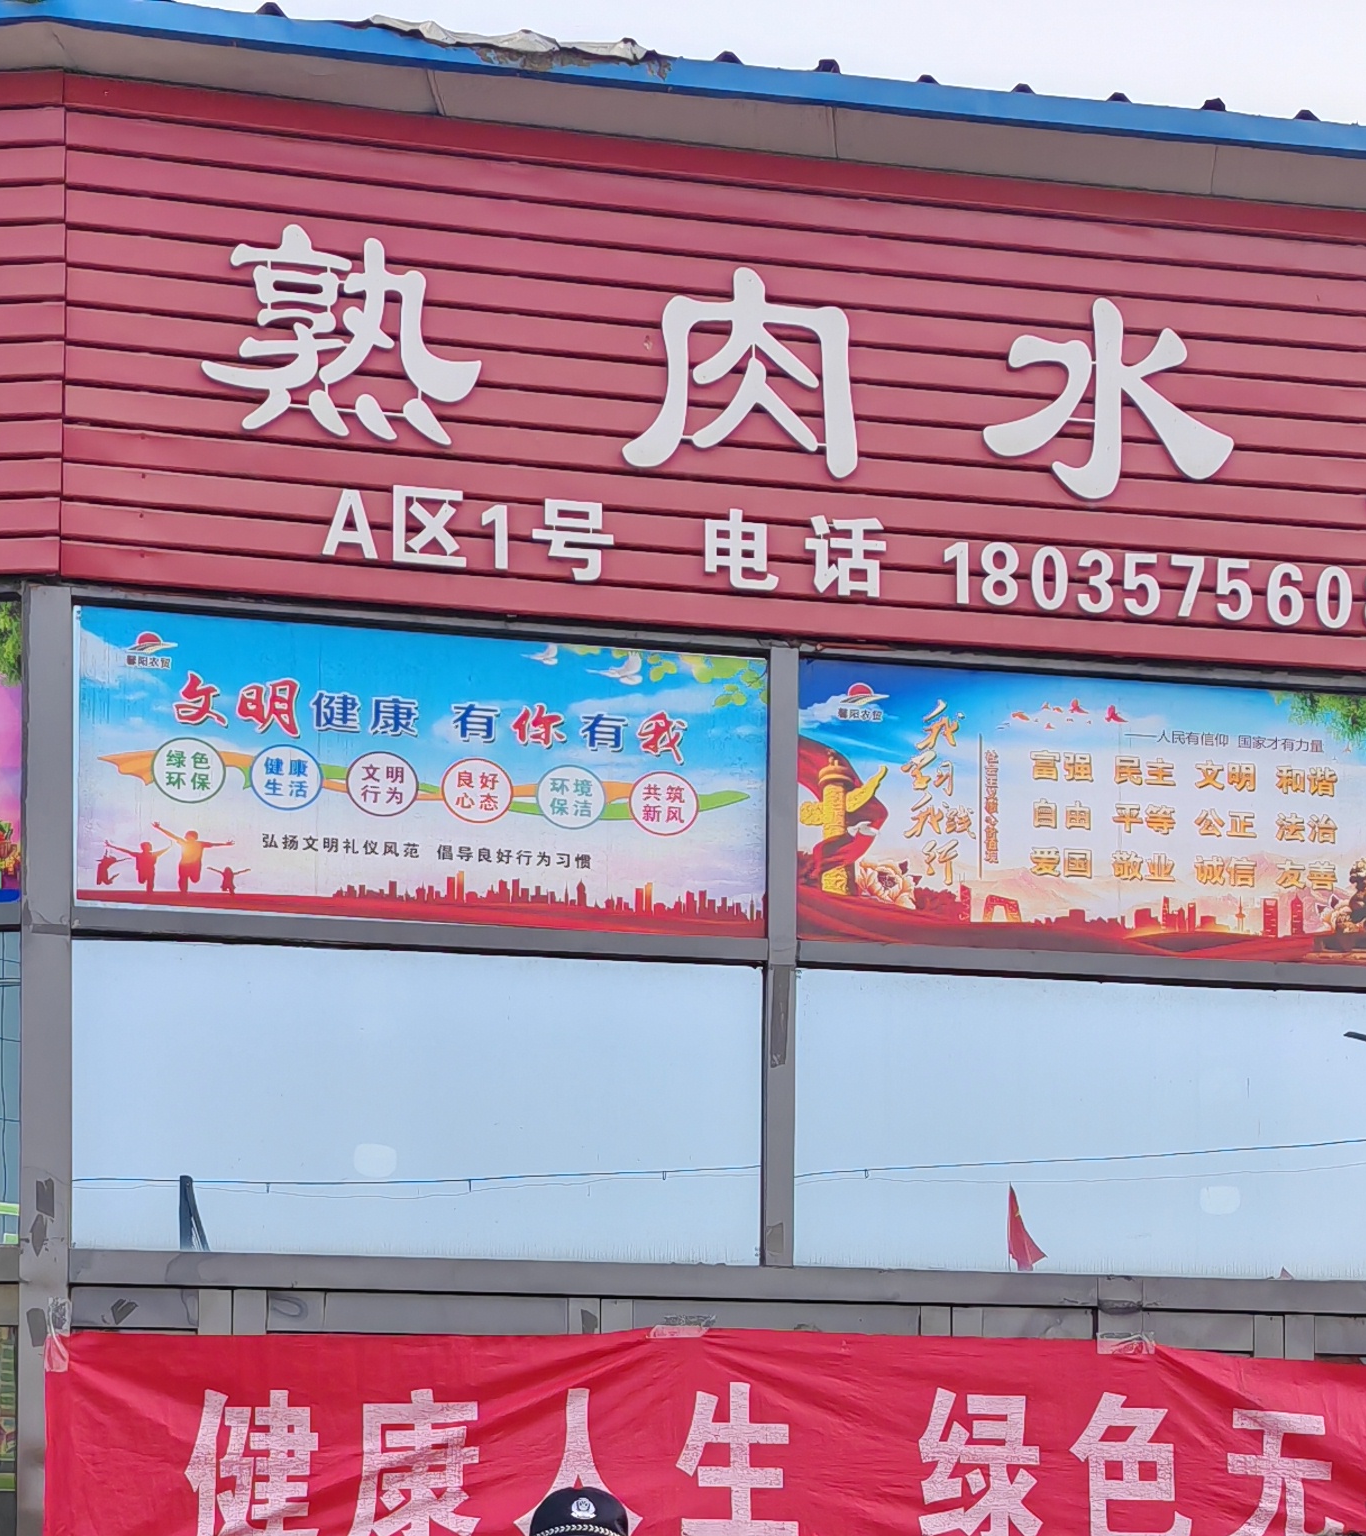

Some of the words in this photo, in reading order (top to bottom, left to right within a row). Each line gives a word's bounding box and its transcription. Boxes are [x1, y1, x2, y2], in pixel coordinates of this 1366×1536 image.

[321, 484, 615, 582] A区1号
[703, 507, 887, 598] 电话
[173, 672, 418, 740] 文明健康
[452, 701, 684, 765] 有你有我
[1238, 733, 1325, 755] 国家才有力量
[165, 747, 211, 769] 绿色
[263, 756, 309, 778] 健康
[165, 769, 211, 791] 环保
[361, 763, 405, 785] 文明
[455, 769, 499, 791] 良好
[1030, 750, 1095, 783] 富强
[1113, 754, 1176, 788] 民主
[1195, 759, 1257, 793] 文明
[1276, 764, 1338, 798] 和谐
[263, 777, 309, 799] 生活
[361, 784, 405, 806] 行为
[549, 776, 593, 798] 环境
[641, 782, 685, 804] 共筑
[455, 790, 499, 812] 心态
[549, 797, 593, 819] 保洁
[641, 803, 685, 825] 新风
[1030, 798, 1093, 832] 自由
[1111, 802, 1176, 836] 平等
[1194, 807, 1258, 840] 公正
[1276, 811, 1338, 845] 法治
[262, 833, 420, 860] 弘扬文明礼仪风范
[437, 844, 592, 871] 倡导良好行为习惯
[1030, 845, 1094, 879] 爱国
[1111, 850, 1176, 884] 敬业
[1194, 854, 1258, 888] 诚信
[1276, 859, 1338, 892] 友善
